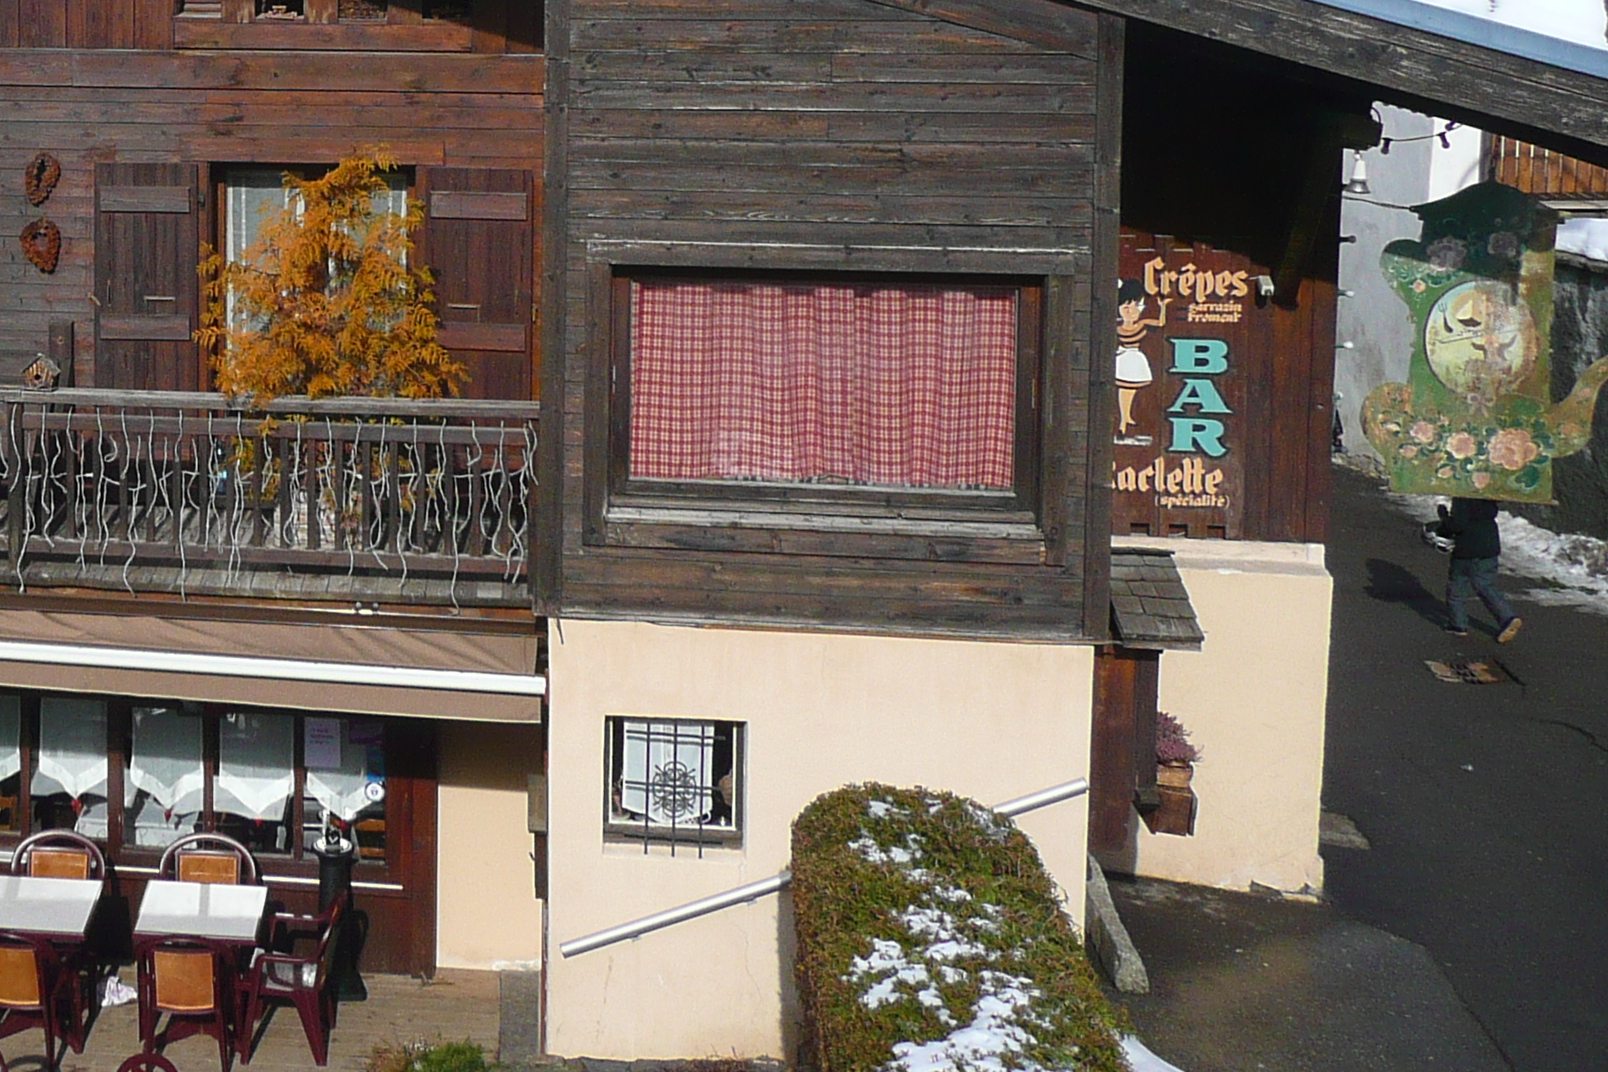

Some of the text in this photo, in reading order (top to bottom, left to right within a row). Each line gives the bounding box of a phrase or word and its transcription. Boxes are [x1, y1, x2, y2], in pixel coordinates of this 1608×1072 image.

[1144, 256, 1249, 303] Crêpes
[1166, 338, 1233, 457] BAR
[1112, 456, 1224, 495] aclette
